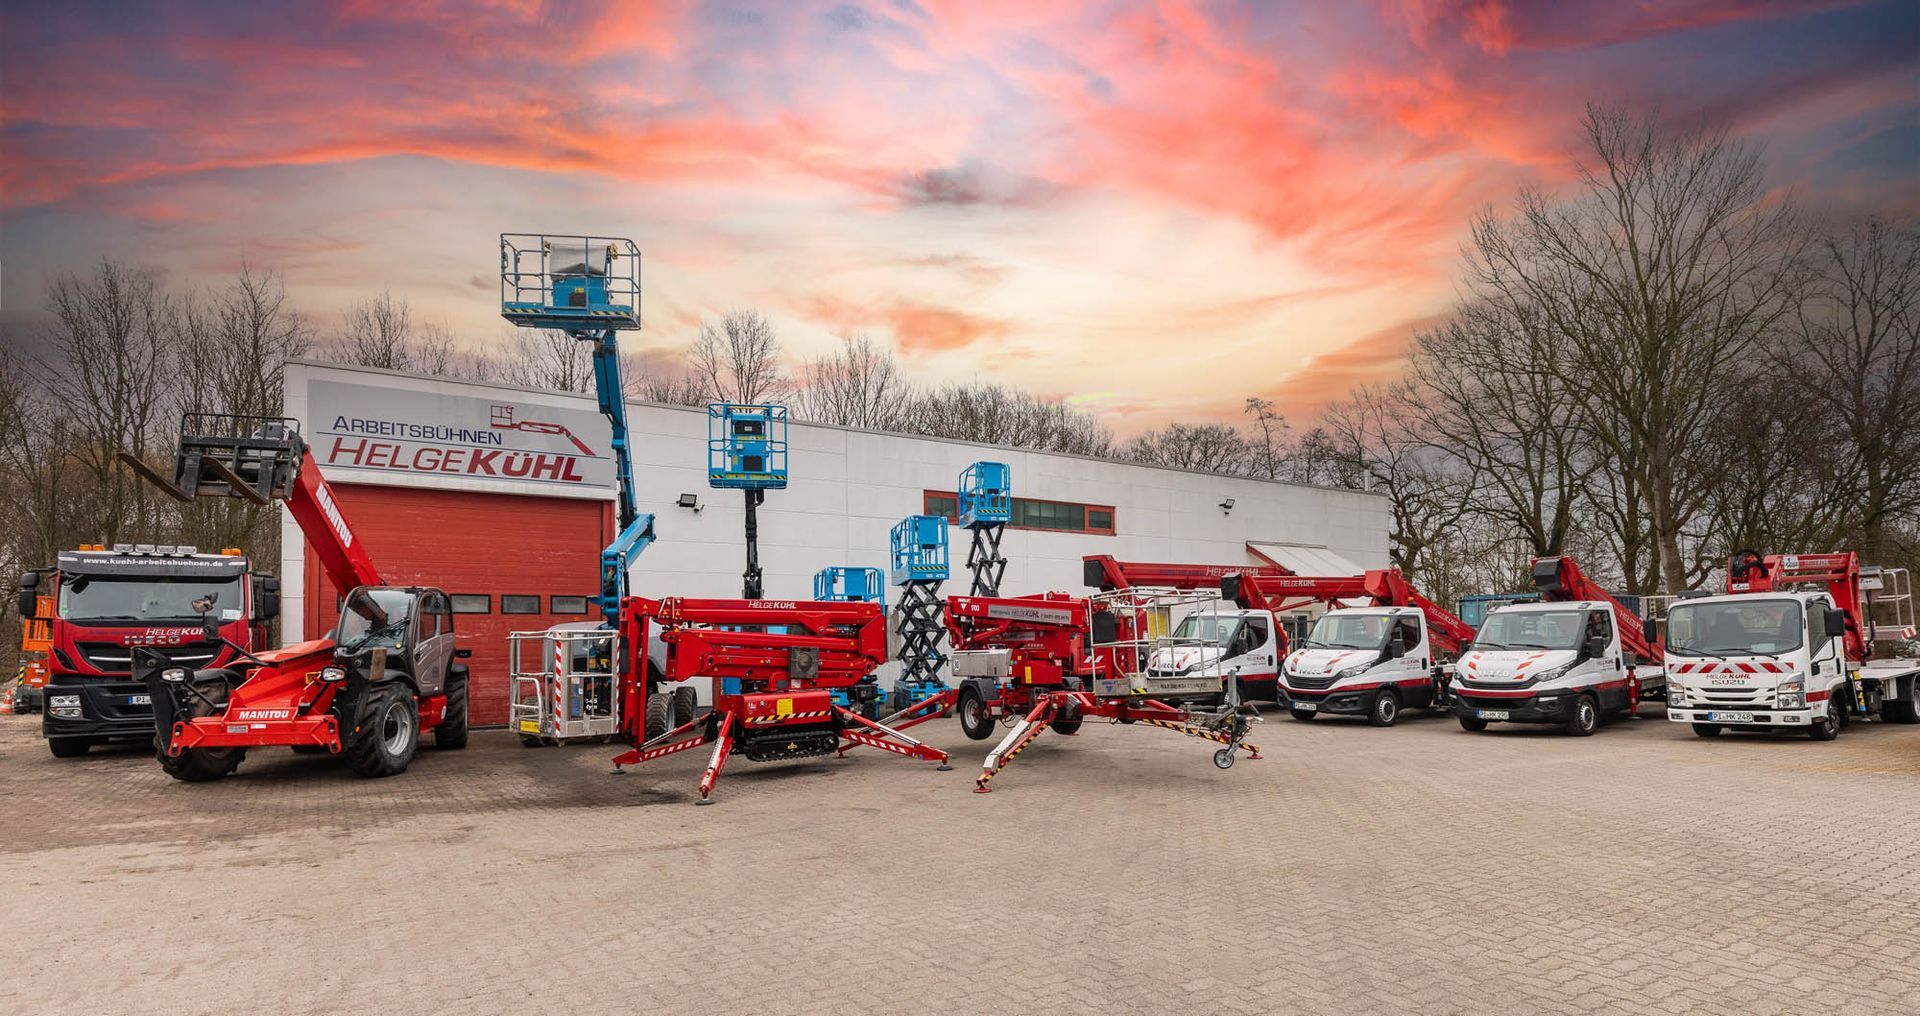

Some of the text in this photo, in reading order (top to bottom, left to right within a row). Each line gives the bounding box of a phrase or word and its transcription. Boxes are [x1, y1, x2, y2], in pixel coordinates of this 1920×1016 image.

[333, 416, 502, 445] ARBEITSBÜHNEN
[315, 482, 353, 548] MANITOU
[83, 558, 223, 567] www.kuehl-arbeitsbuehnen.de
[124, 635, 181, 645] IVECO
[239, 710, 289, 720] MANITOU
